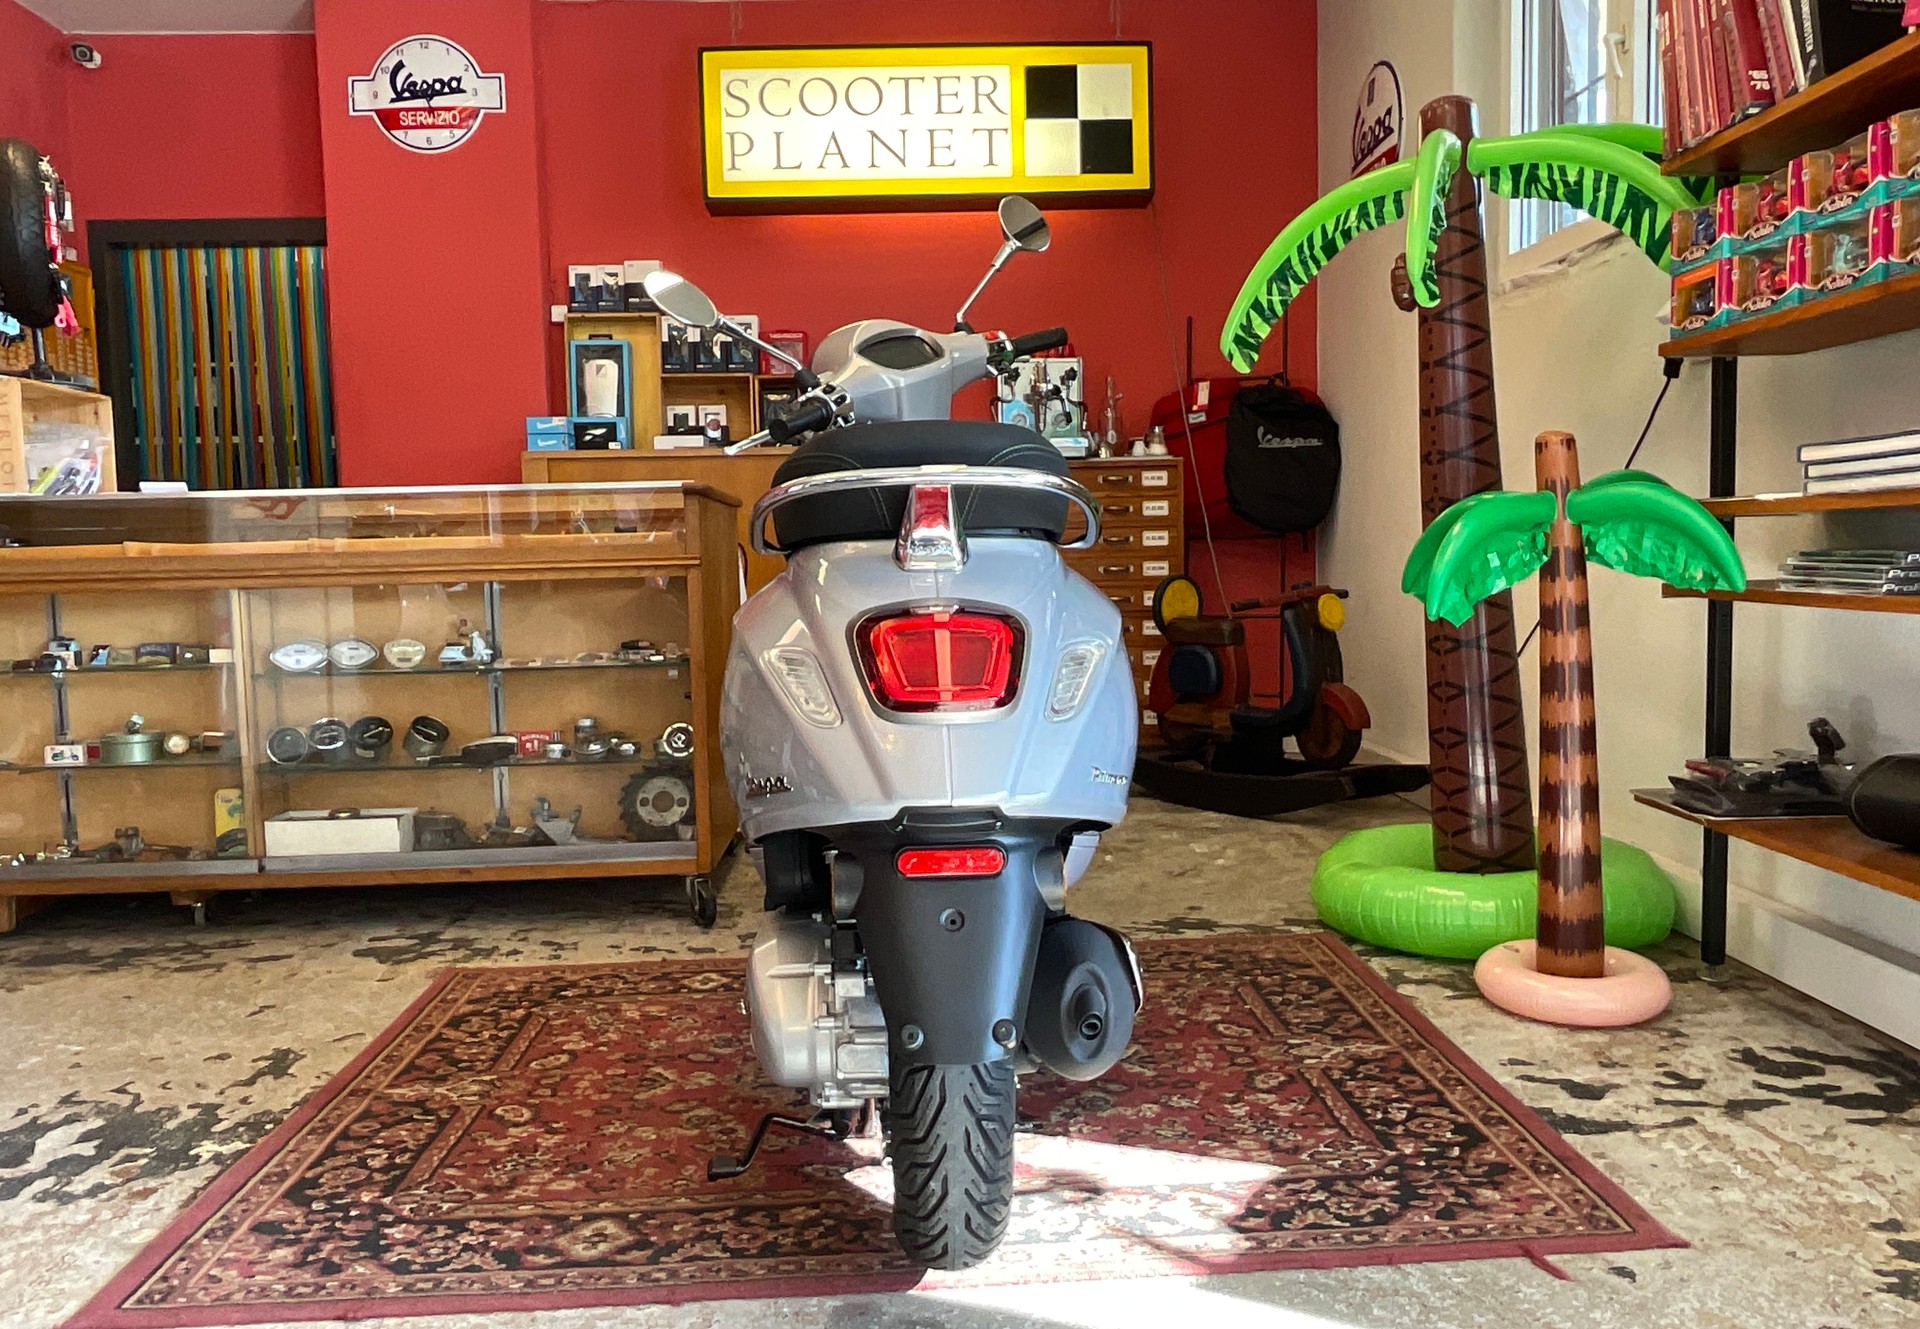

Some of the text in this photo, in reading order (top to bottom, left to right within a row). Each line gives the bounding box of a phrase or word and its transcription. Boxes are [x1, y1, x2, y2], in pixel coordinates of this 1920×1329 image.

[380, 66, 391, 75] 10
[463, 64, 470, 72] 2
[389, 59, 467, 104] Vespa
[471, 88, 478, 97] 3
[724, 75, 1009, 118] SCOOTER
[399, 110, 461, 126] SERVIZIO
[426, 136, 433, 146] 6
[1351, 104, 1395, 174] Vespa
[726, 127, 1009, 172] PLANET
[1257, 426, 1323, 448] Vespa
